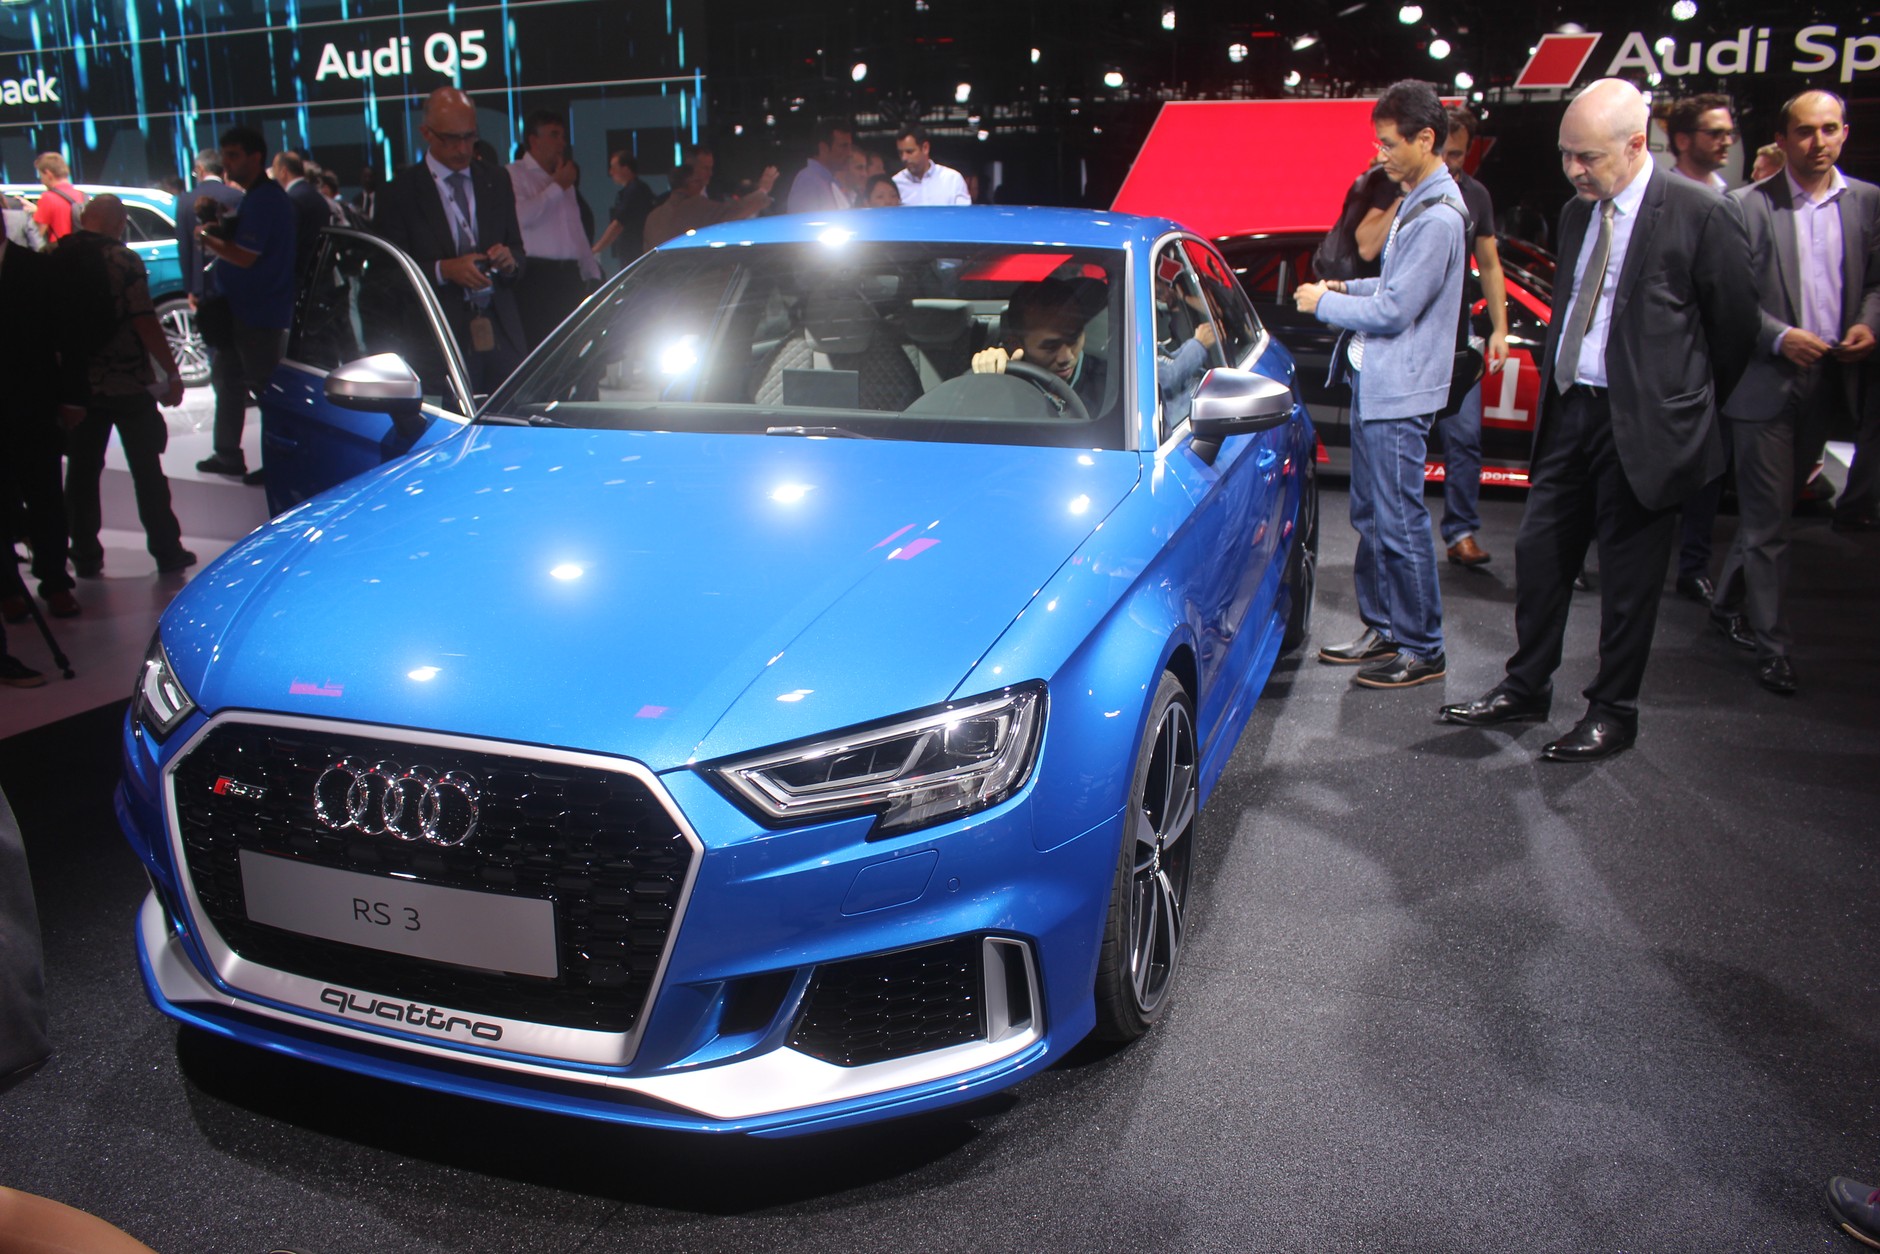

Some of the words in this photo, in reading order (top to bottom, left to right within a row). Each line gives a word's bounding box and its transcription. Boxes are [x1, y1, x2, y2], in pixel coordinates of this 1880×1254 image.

[315, 36, 412, 81] Audi
[424, 29, 487, 77] Q5
[1605, 26, 1770, 76] Audi
[1791, 25, 1880, 83] Sp
[1484, 357, 1528, 422] 1
[353, 897, 391, 926] RS
[403, 907, 421, 931] 3
[320, 987, 504, 1042] quattro
